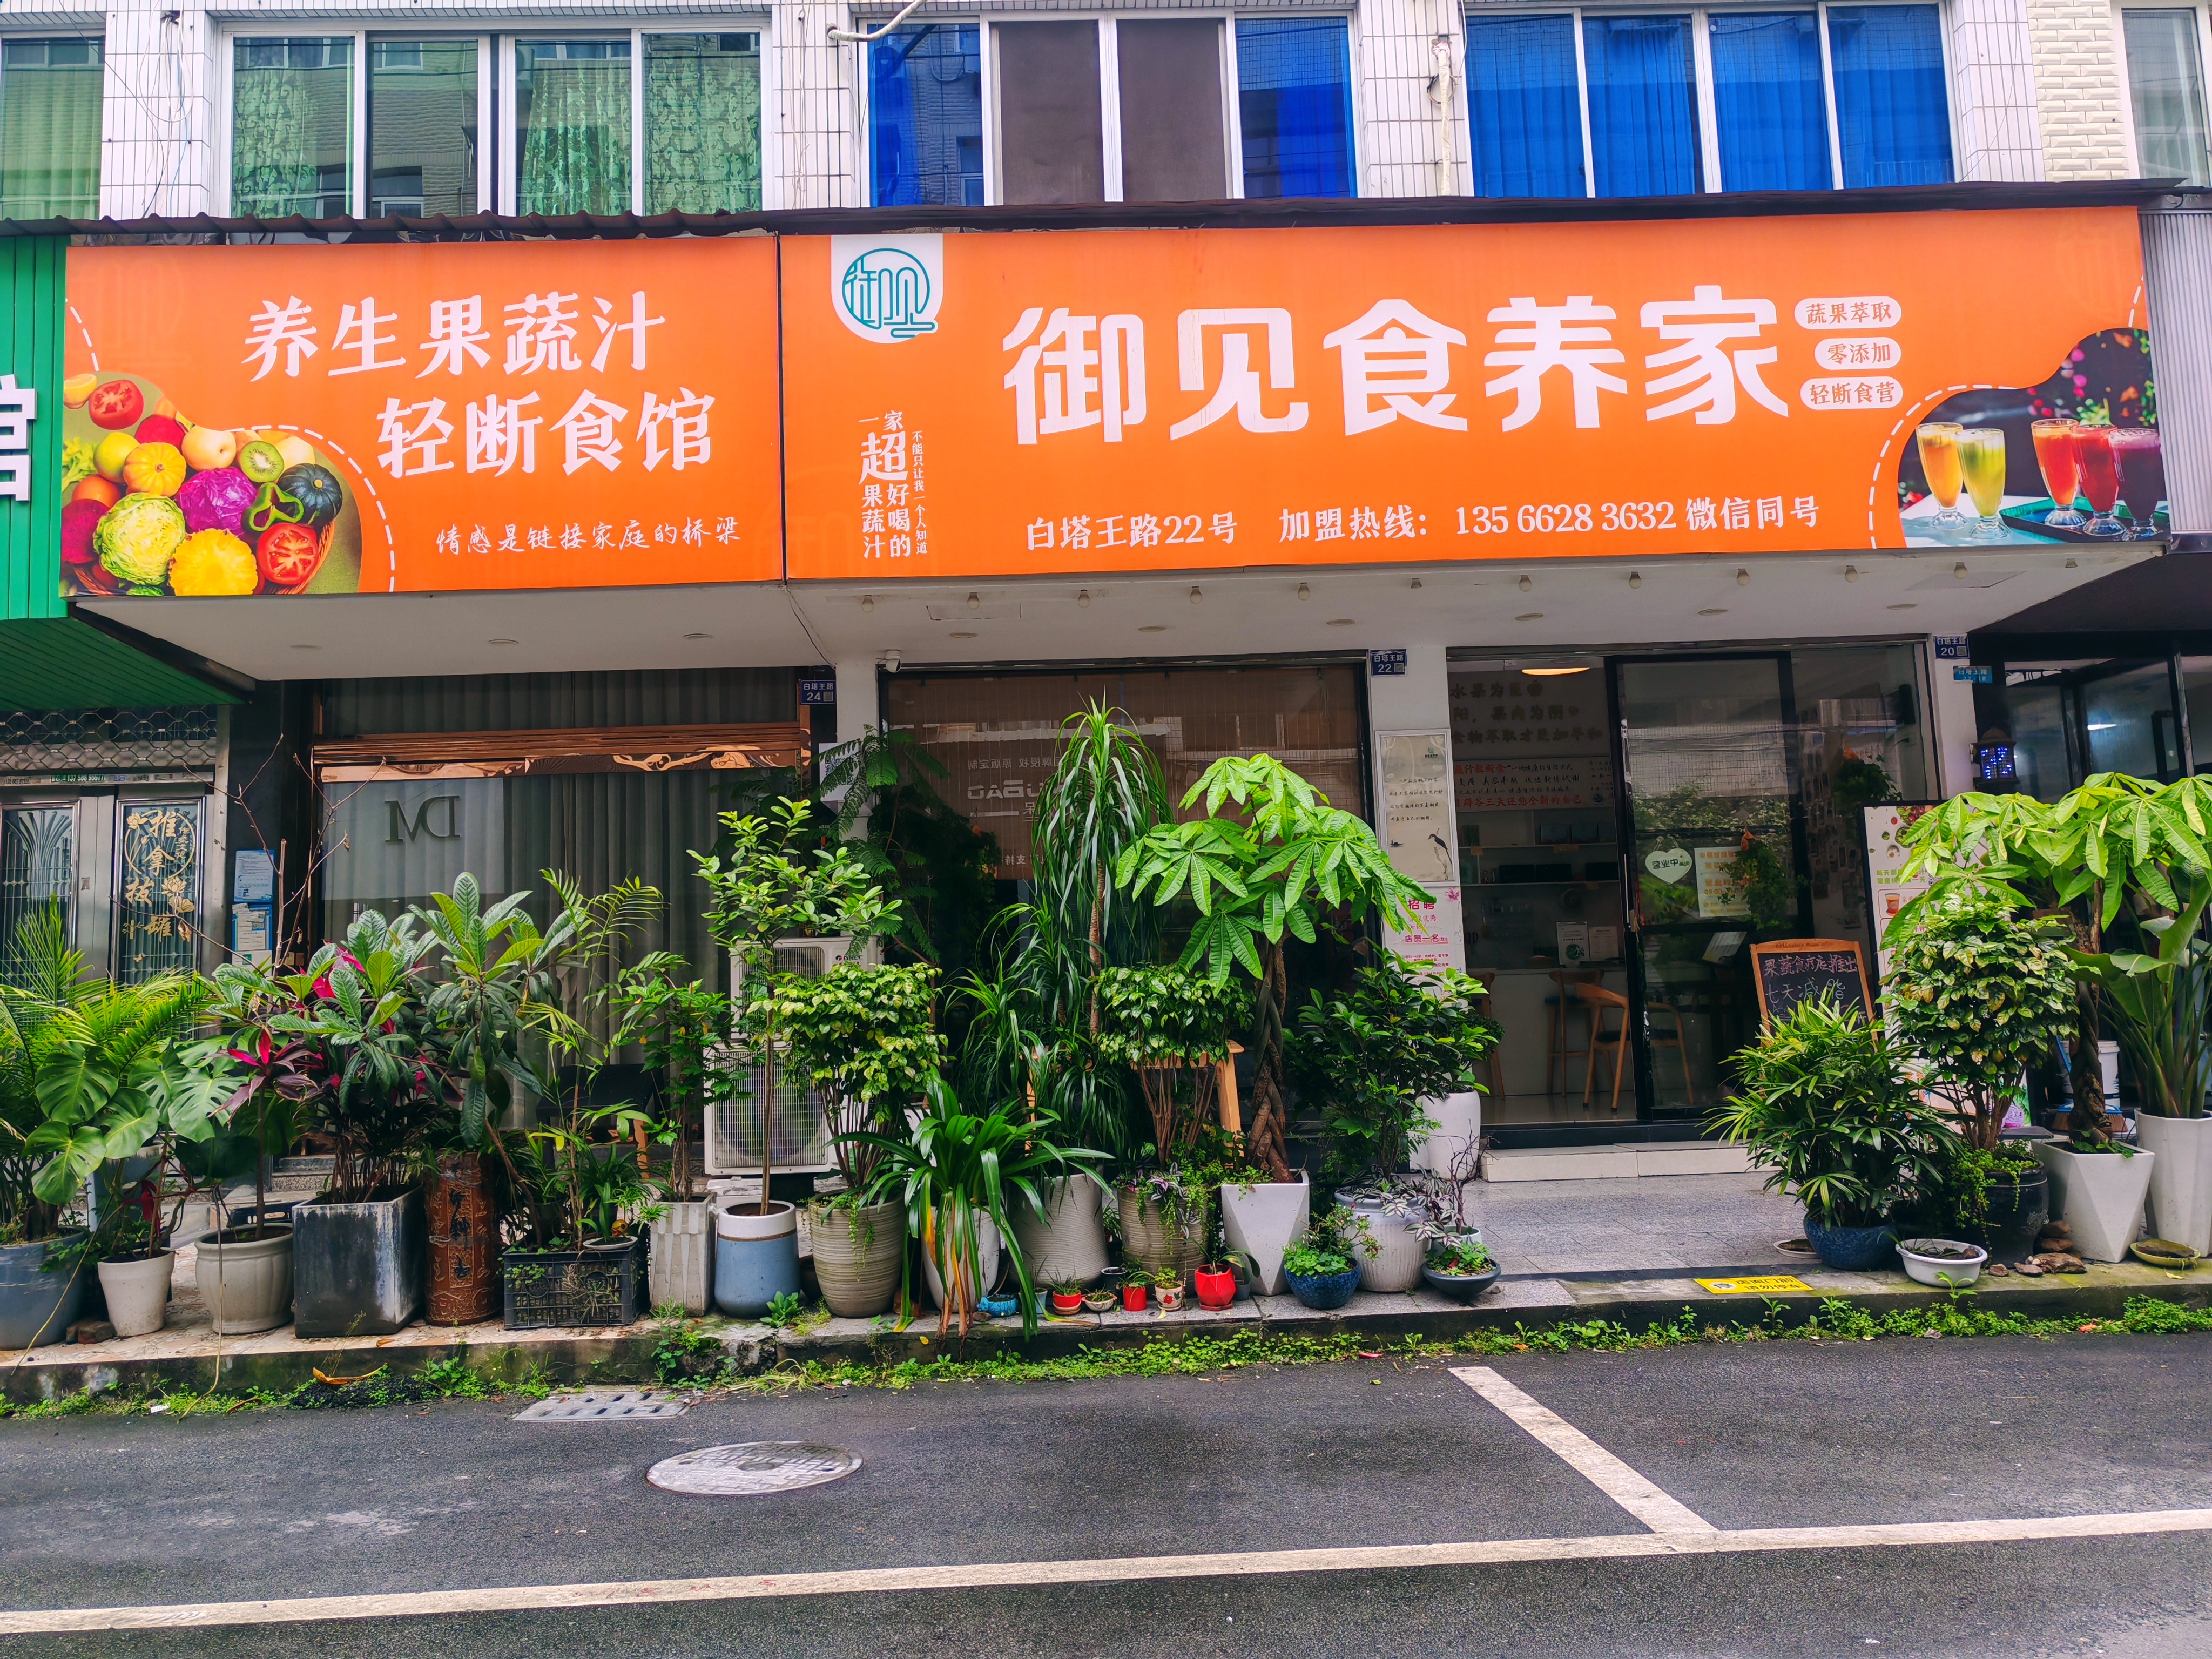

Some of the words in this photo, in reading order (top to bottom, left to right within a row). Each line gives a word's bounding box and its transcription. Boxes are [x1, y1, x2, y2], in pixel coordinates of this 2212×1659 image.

[1806, 302, 1891, 324] 蔬果萃取
[242, 291, 665, 382] 养生果蔬汁
[1827, 342, 1890, 364] 零添加
[1003, 285, 1789, 445] 御见食养家
[1809, 381, 1894, 404] 轻断食营
[377, 387, 715, 479] 轻断食馆
[912, 430, 928, 554] 不能只让我一个人知道
[1028, 512, 1237, 551] 白塔王路22号
[1457, 506, 1509, 534] 135
[1518, 504, 1594, 533] 6628
[1601, 502, 1677, 531] 3632
[1686, 496, 1819, 531] 微信同号
[436, 517, 740, 555] 情感是链接家庭的桥梁
[1374, 654, 1404, 662] 白塔王路
[1941, 647, 1954, 656] 20
[1378, 664, 1392, 673] 22
[807, 692, 821, 701] 24
[1651, 858, 1678, 869] 营业中
[1763, 954, 1858, 977] 果蔬食疗店推出
